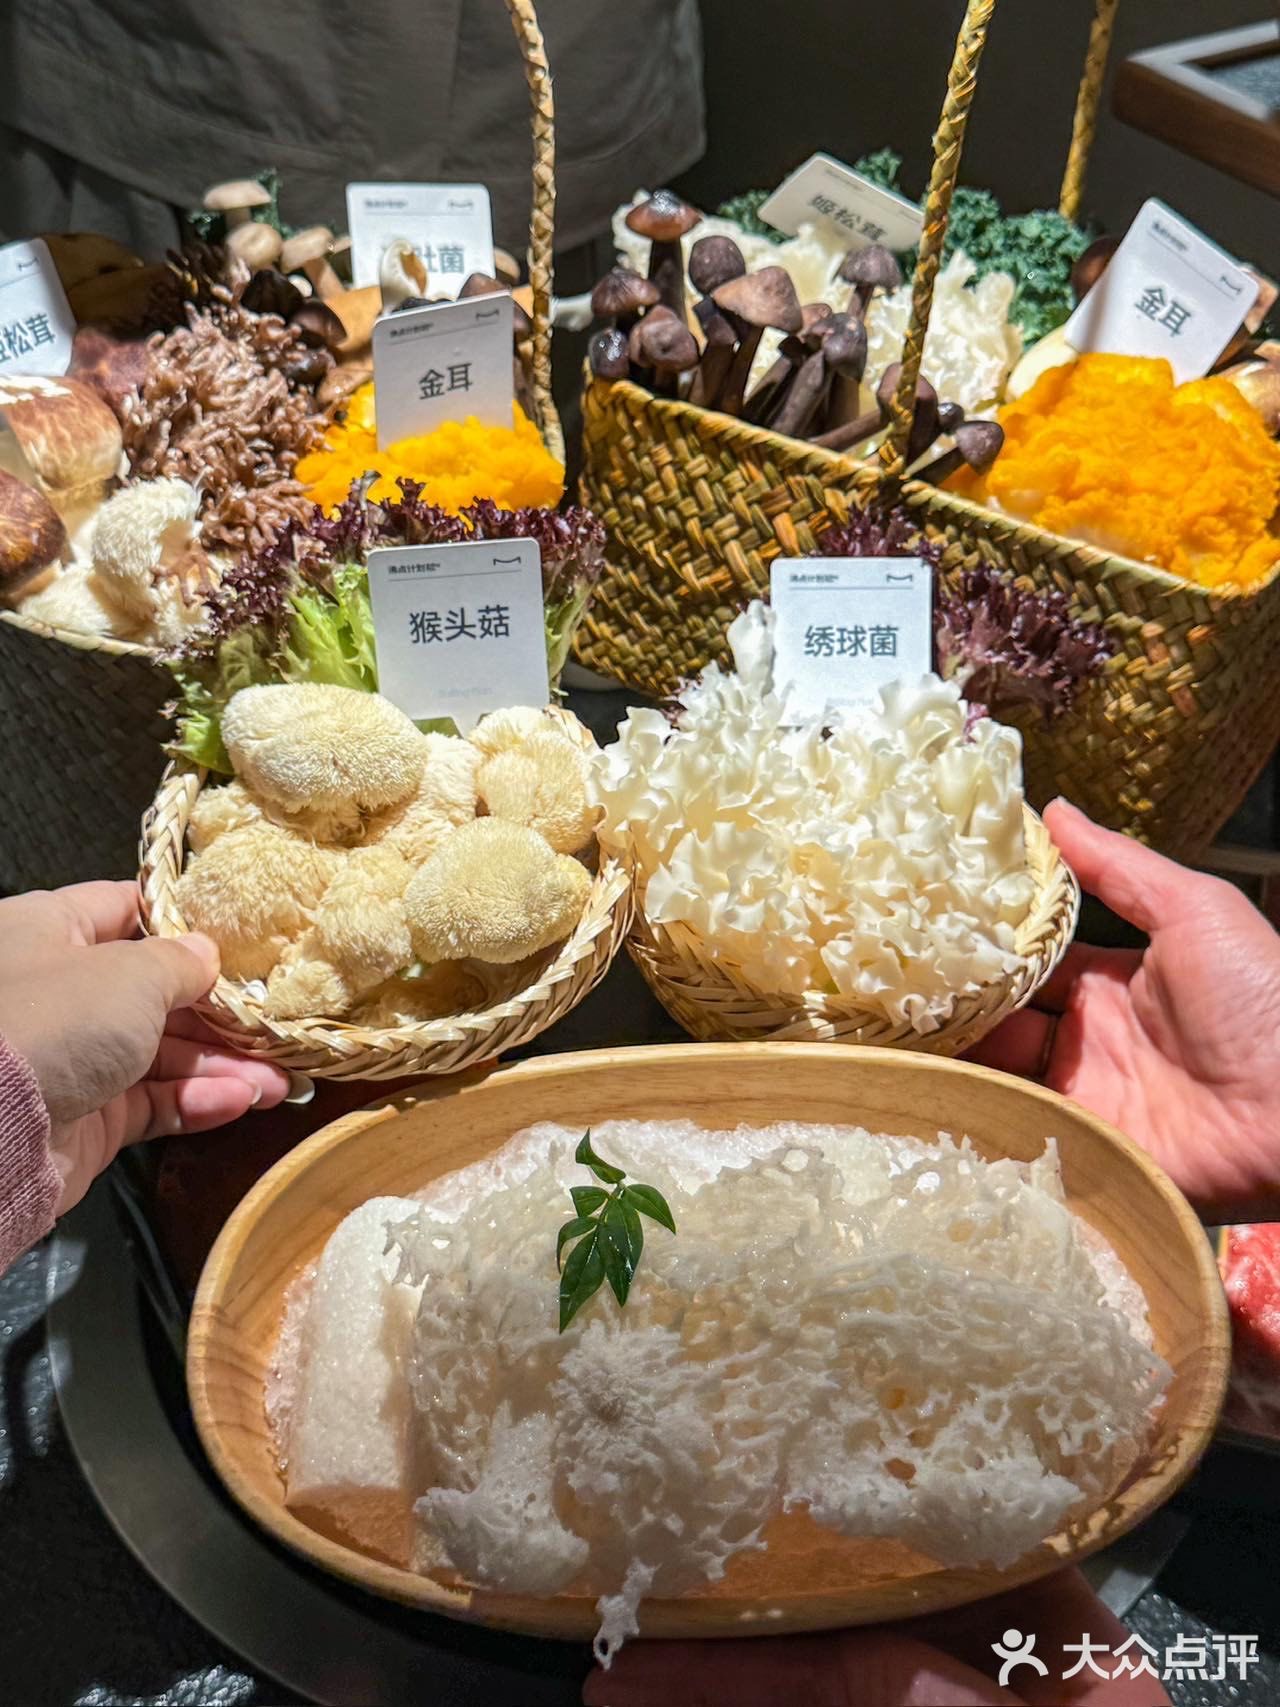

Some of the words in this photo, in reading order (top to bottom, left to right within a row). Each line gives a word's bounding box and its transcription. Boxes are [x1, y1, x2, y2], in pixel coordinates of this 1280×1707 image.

[1134, 286, 1192, 338] 金耳
[419, 362, 473, 400] 金耳
[409, 605, 511, 644] 猴头菇
[804, 625, 899, 658] 绣球菌
